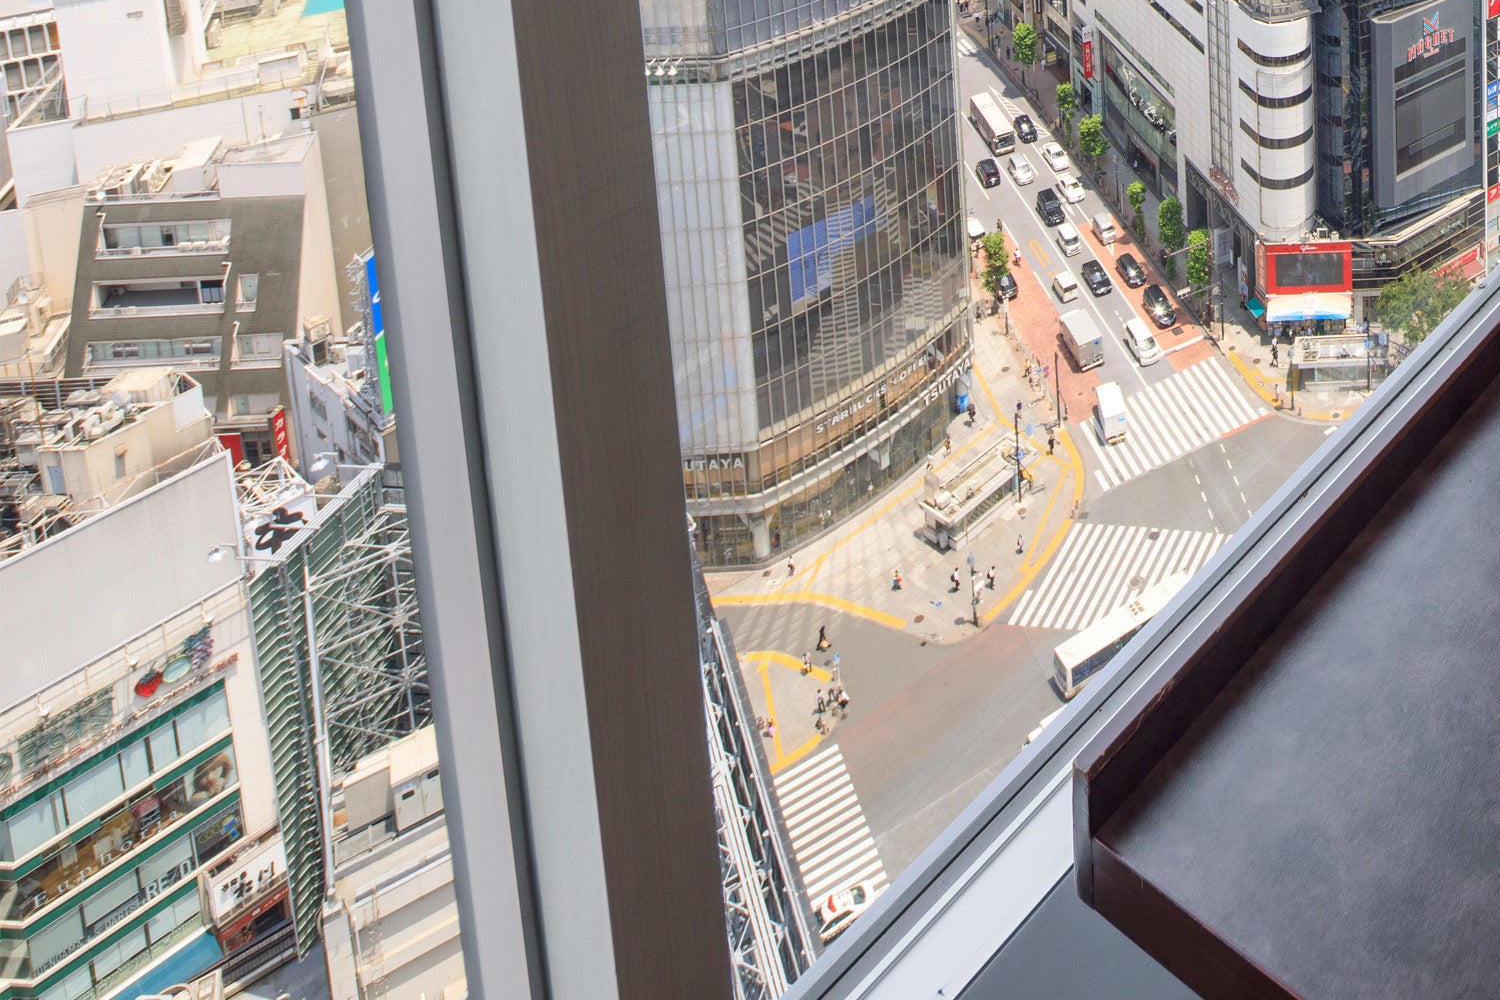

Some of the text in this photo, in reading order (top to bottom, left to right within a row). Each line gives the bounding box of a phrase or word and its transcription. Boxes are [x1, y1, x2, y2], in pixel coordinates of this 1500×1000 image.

[1407, 28, 1455, 63] MAGNET
[923, 358, 971, 407] TSUTAYA
[816, 384, 887, 434] STARBUCKS
[33, 810, 177, 909] Euphoria
